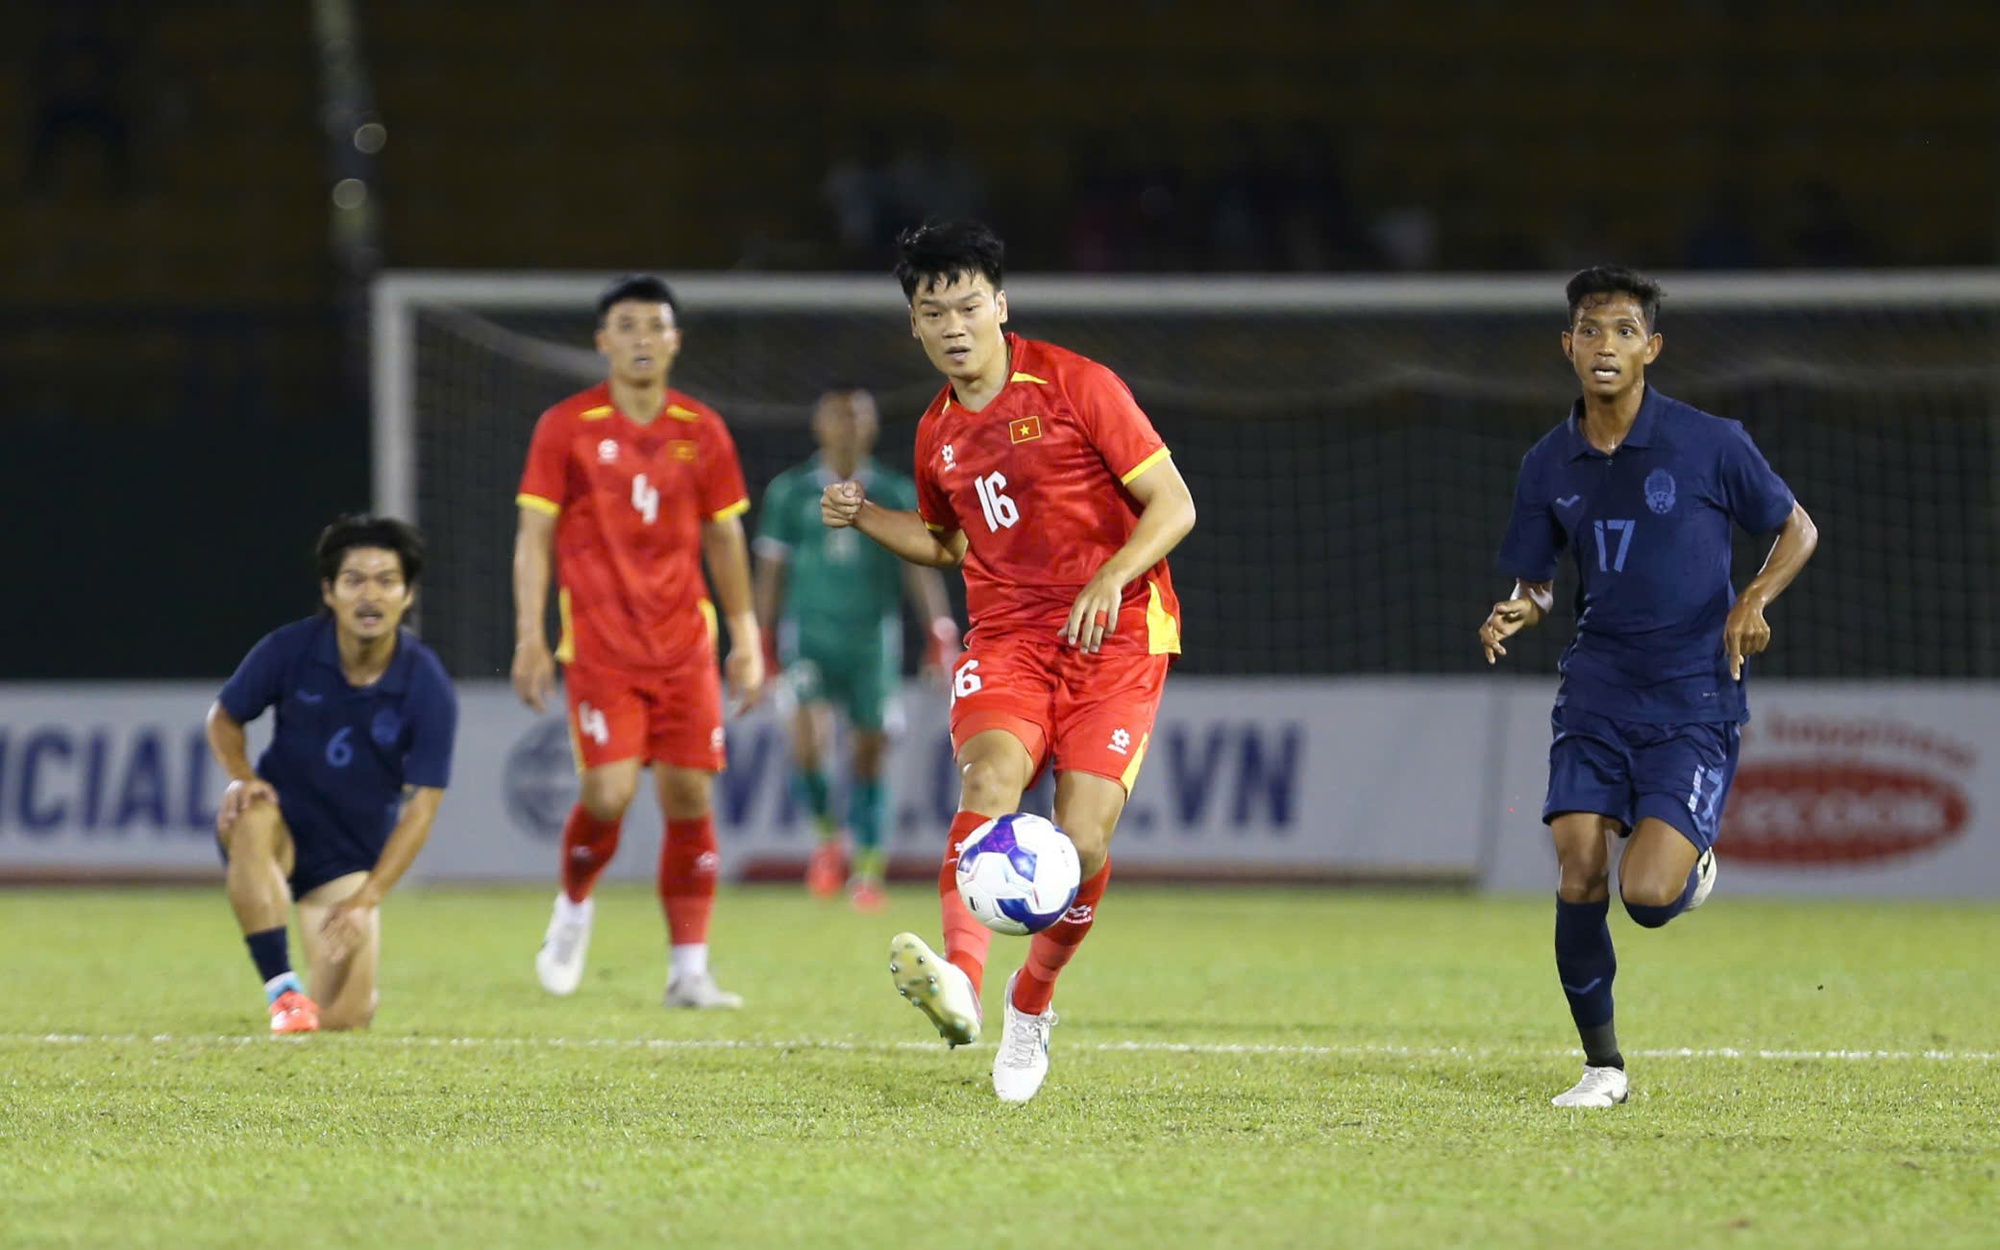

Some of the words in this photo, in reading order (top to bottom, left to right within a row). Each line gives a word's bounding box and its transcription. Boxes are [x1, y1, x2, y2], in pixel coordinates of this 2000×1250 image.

[631, 473, 659, 523] 4
[974, 470, 1020, 533] 16
[1593, 519, 1636, 572] 17
[950, 659, 982, 709] 6
[326, 725, 354, 767] 6
[579, 701, 609, 745] 4
[1688, 764, 1724, 822] 17
